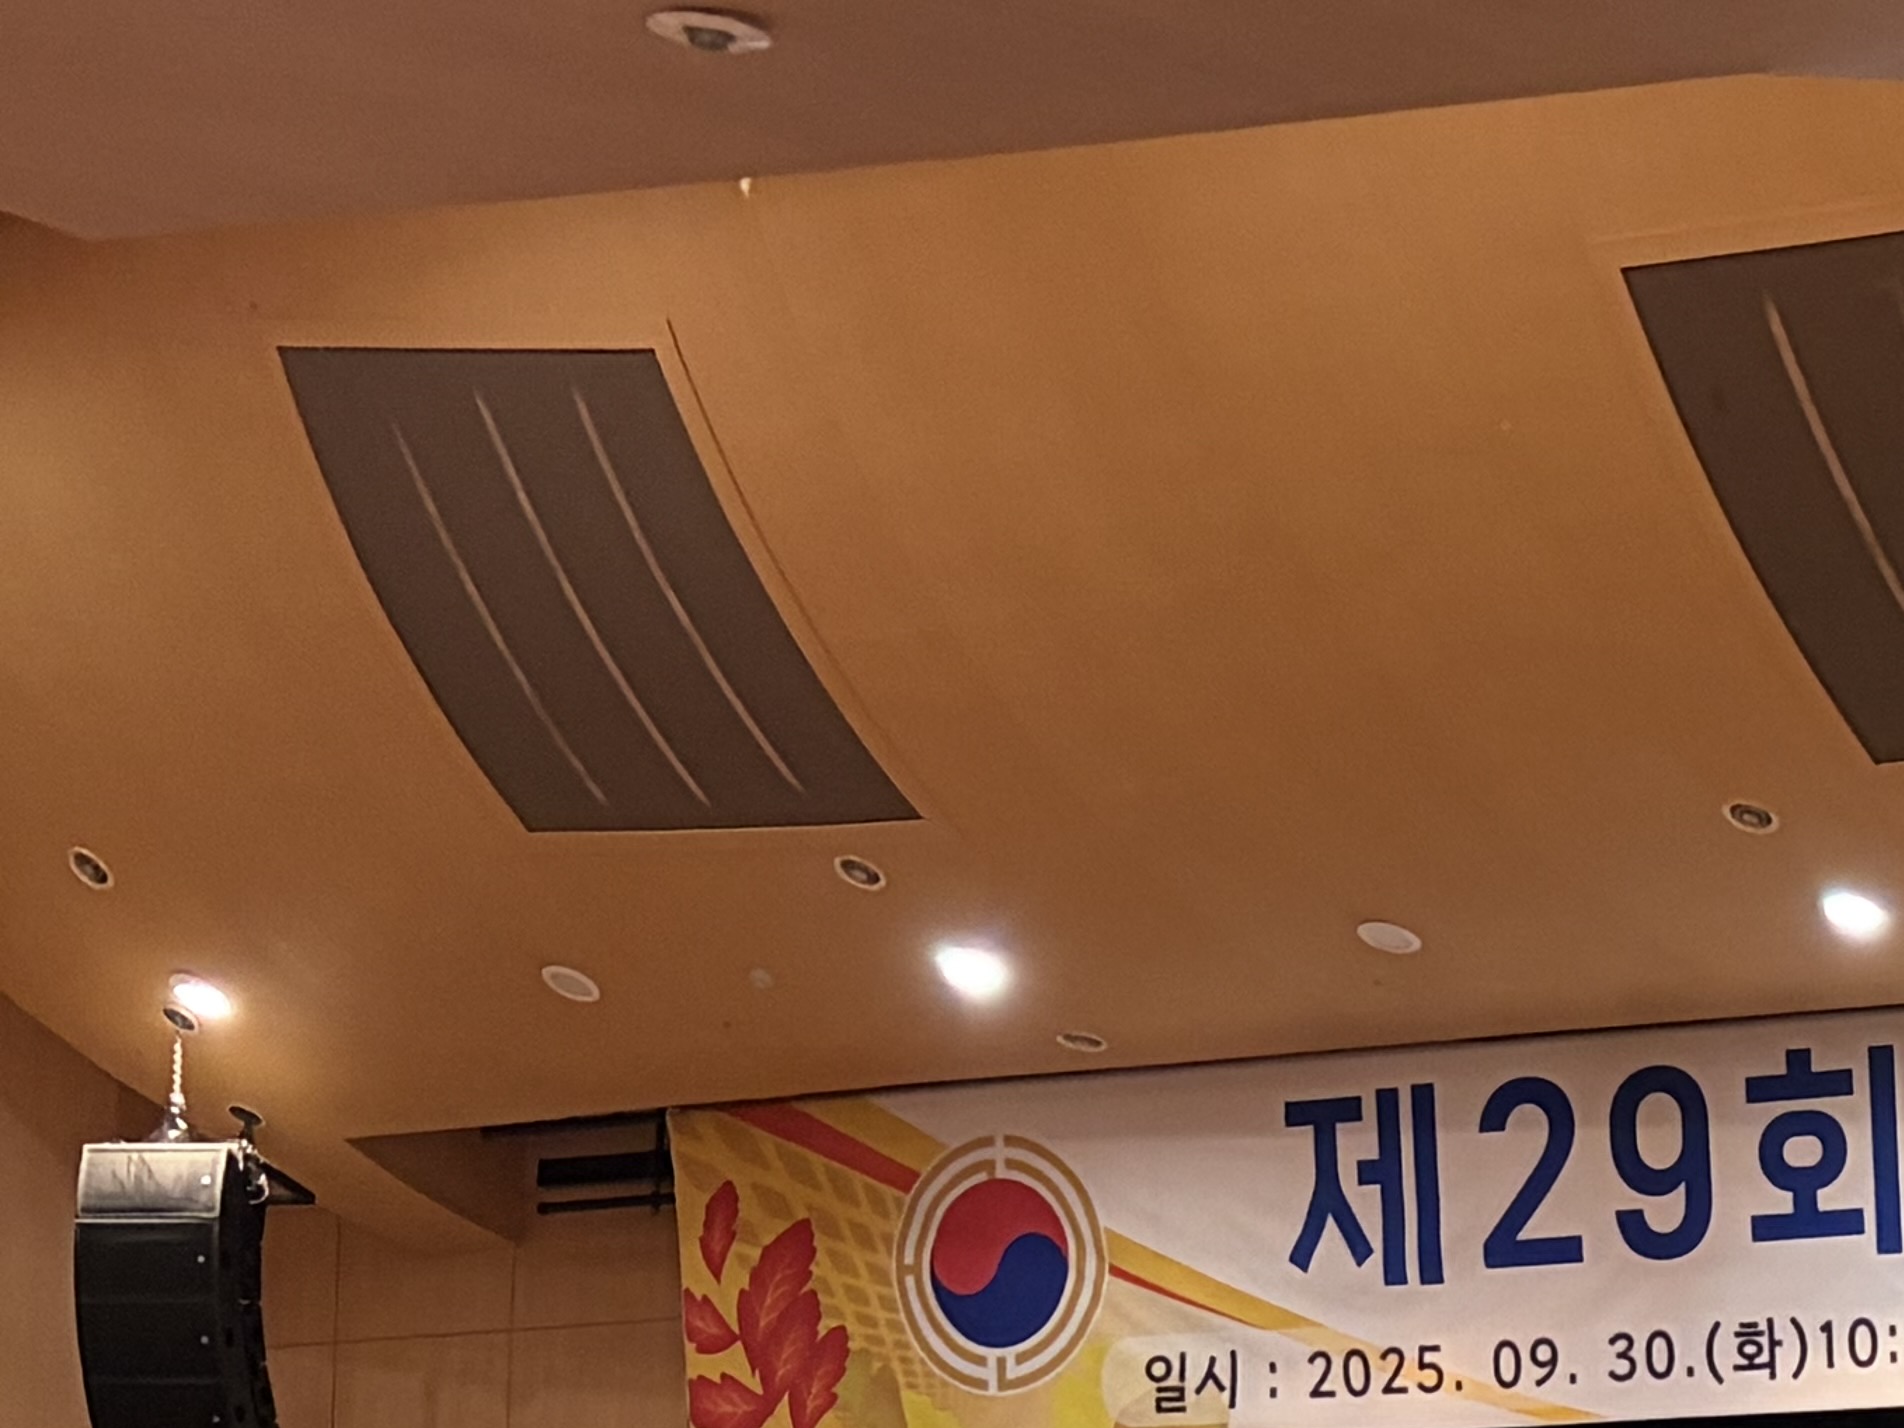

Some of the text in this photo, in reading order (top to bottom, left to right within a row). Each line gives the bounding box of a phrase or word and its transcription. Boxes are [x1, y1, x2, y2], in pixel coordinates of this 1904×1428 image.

[1283, 1044, 1904, 1290] 제29회
[1143, 1348, 1239, 1414] 일시
[1306, 1343, 1464, 1400] 2025.
[1492, 1336, 1578, 1391] 09.
